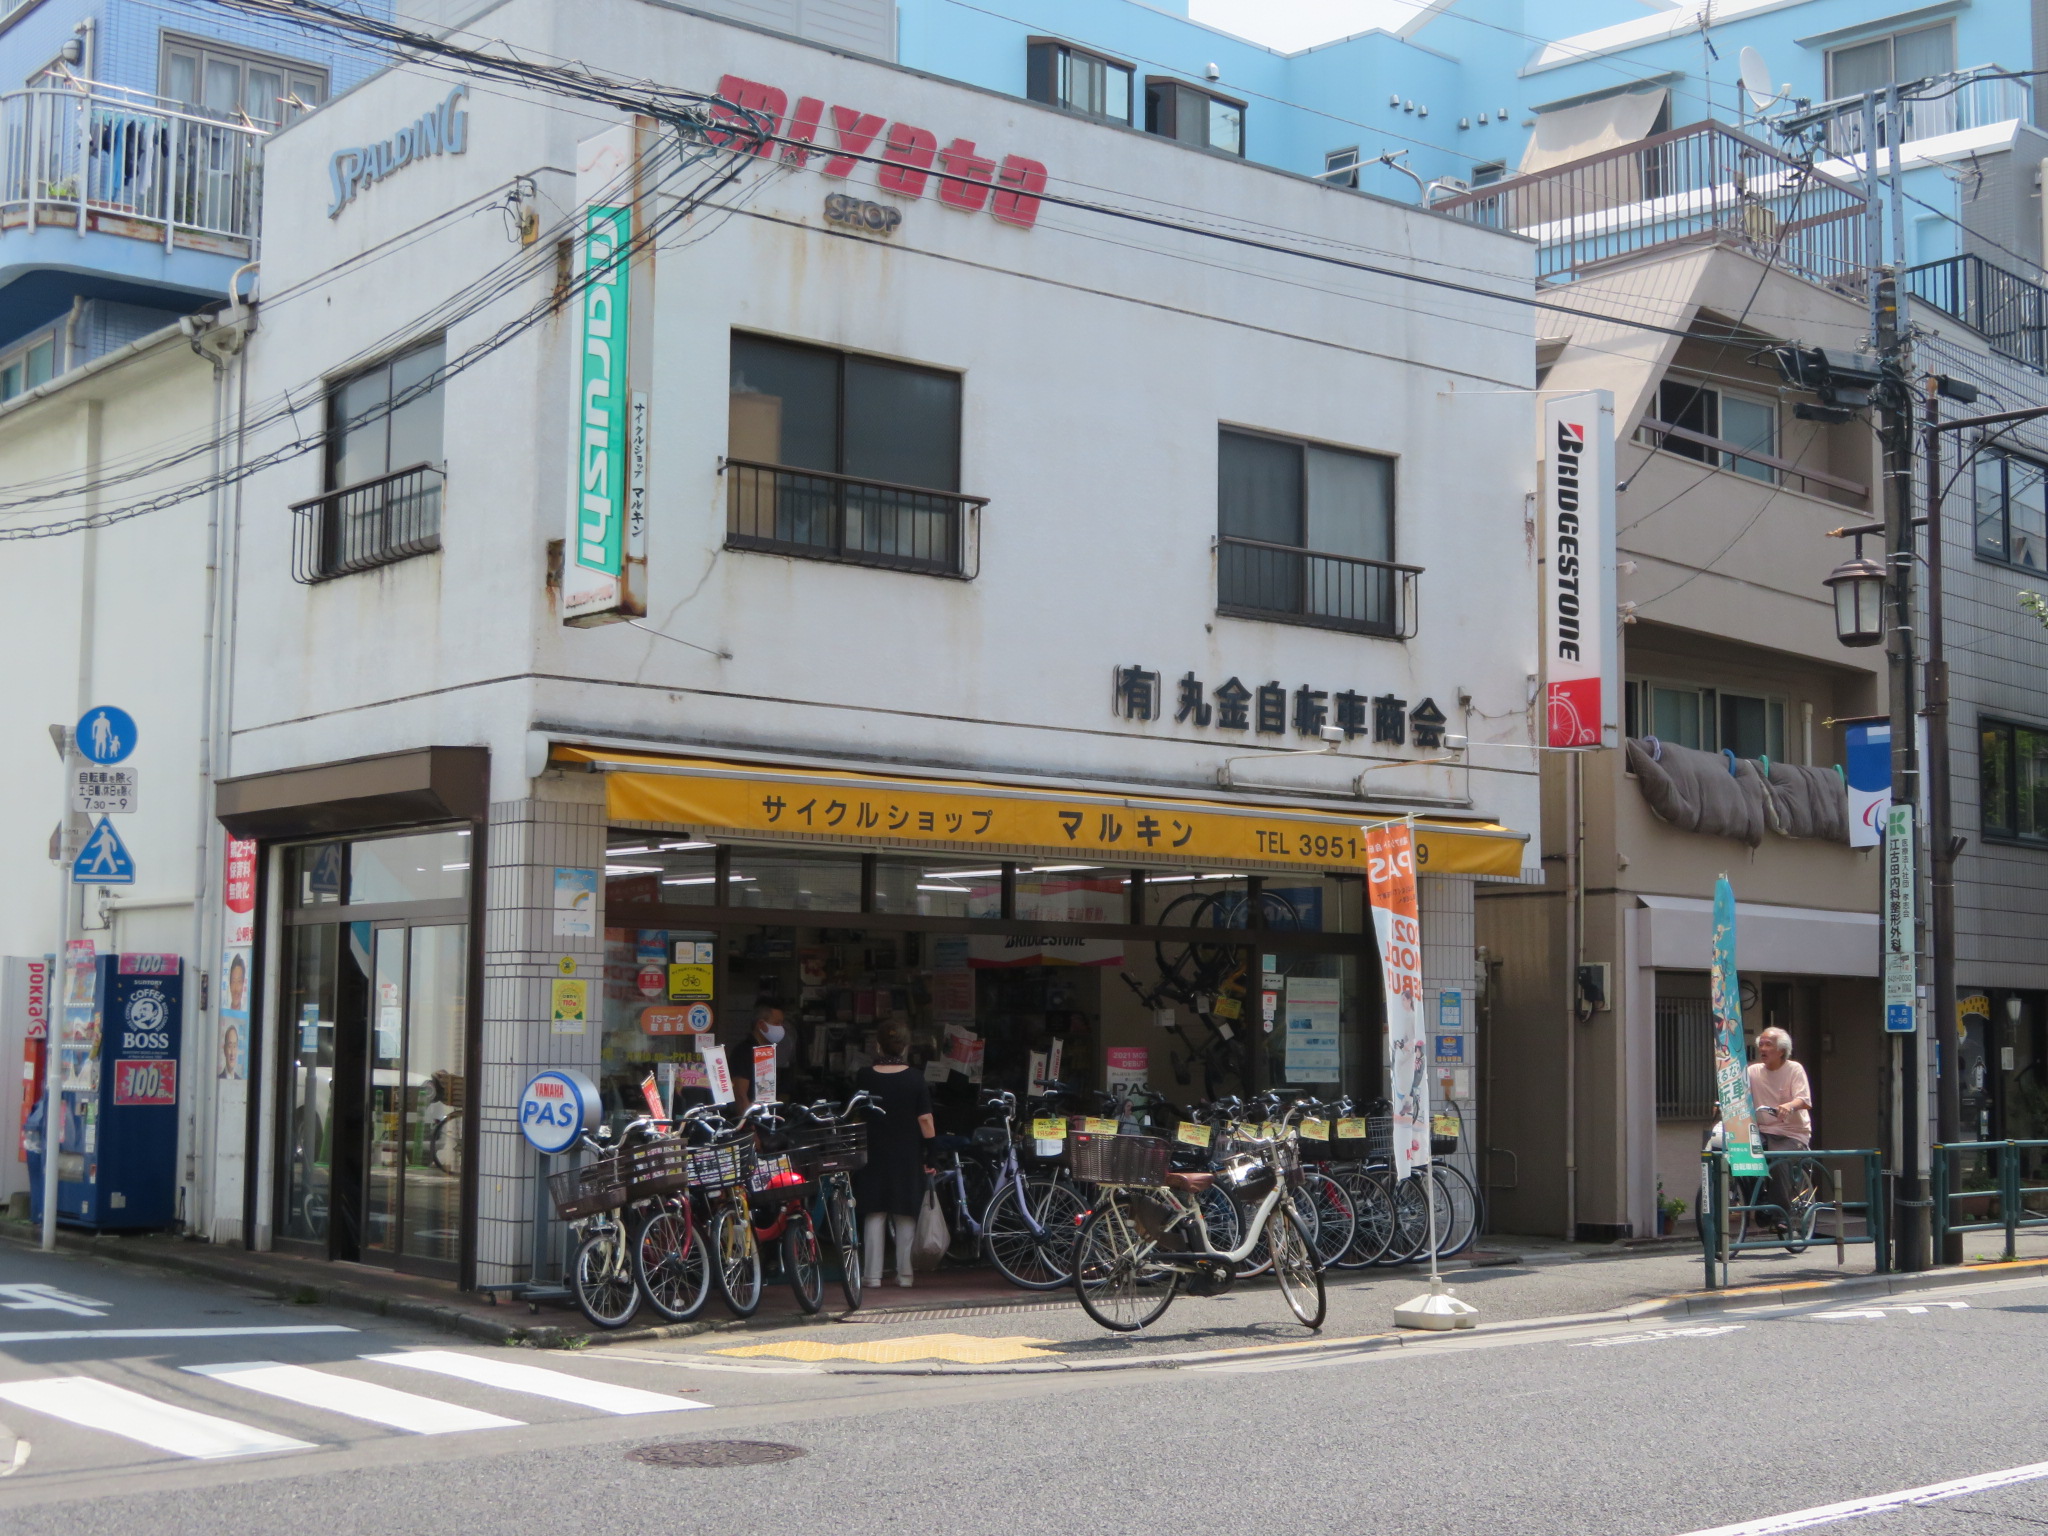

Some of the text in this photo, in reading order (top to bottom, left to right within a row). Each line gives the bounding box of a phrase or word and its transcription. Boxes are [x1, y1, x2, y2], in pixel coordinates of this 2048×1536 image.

[328, 81, 469, 221] SPALDING
[824, 192, 902, 237] SHOP
[582, 212, 619, 566] marushi
[632, 402, 645, 538] サイクルショップ マルキン
[1557, 418, 1584, 662] BRIDGESTONE
[79, 771, 133, 784] 自転車を除く
[762, 795, 993, 835] サイクルショップ
[1058, 810, 1192, 848] マルキン
[1256, 830, 1290, 855] TEL
[130, 988, 166, 1002] COFFEE
[650, 1014, 683, 1023] TSマーク
[123, 1032, 169, 1049] BOSS
[535, 1082, 565, 1098] YAMAHA
[717, 1064, 729, 1094] YAMAHA
[522, 1100, 574, 1127] PAS
